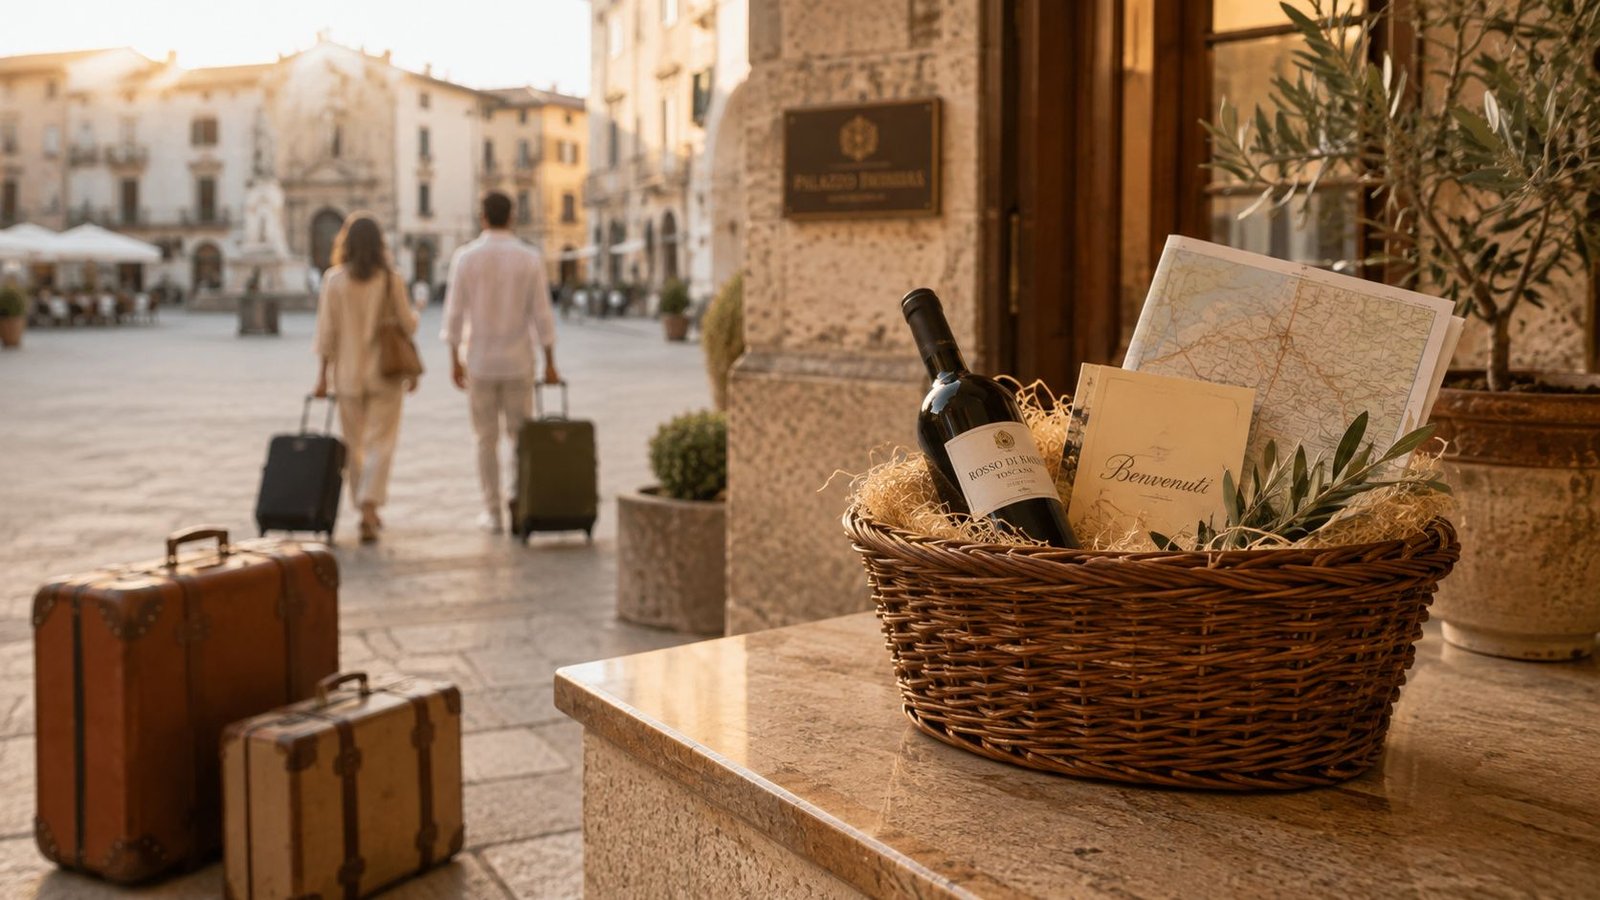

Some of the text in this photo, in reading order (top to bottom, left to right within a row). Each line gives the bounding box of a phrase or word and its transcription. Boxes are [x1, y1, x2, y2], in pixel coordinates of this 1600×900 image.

[968, 460, 1003, 481] ROSSO
[1006, 457, 1019, 466] DI
[1100, 454, 1213, 494] Benvenuti
